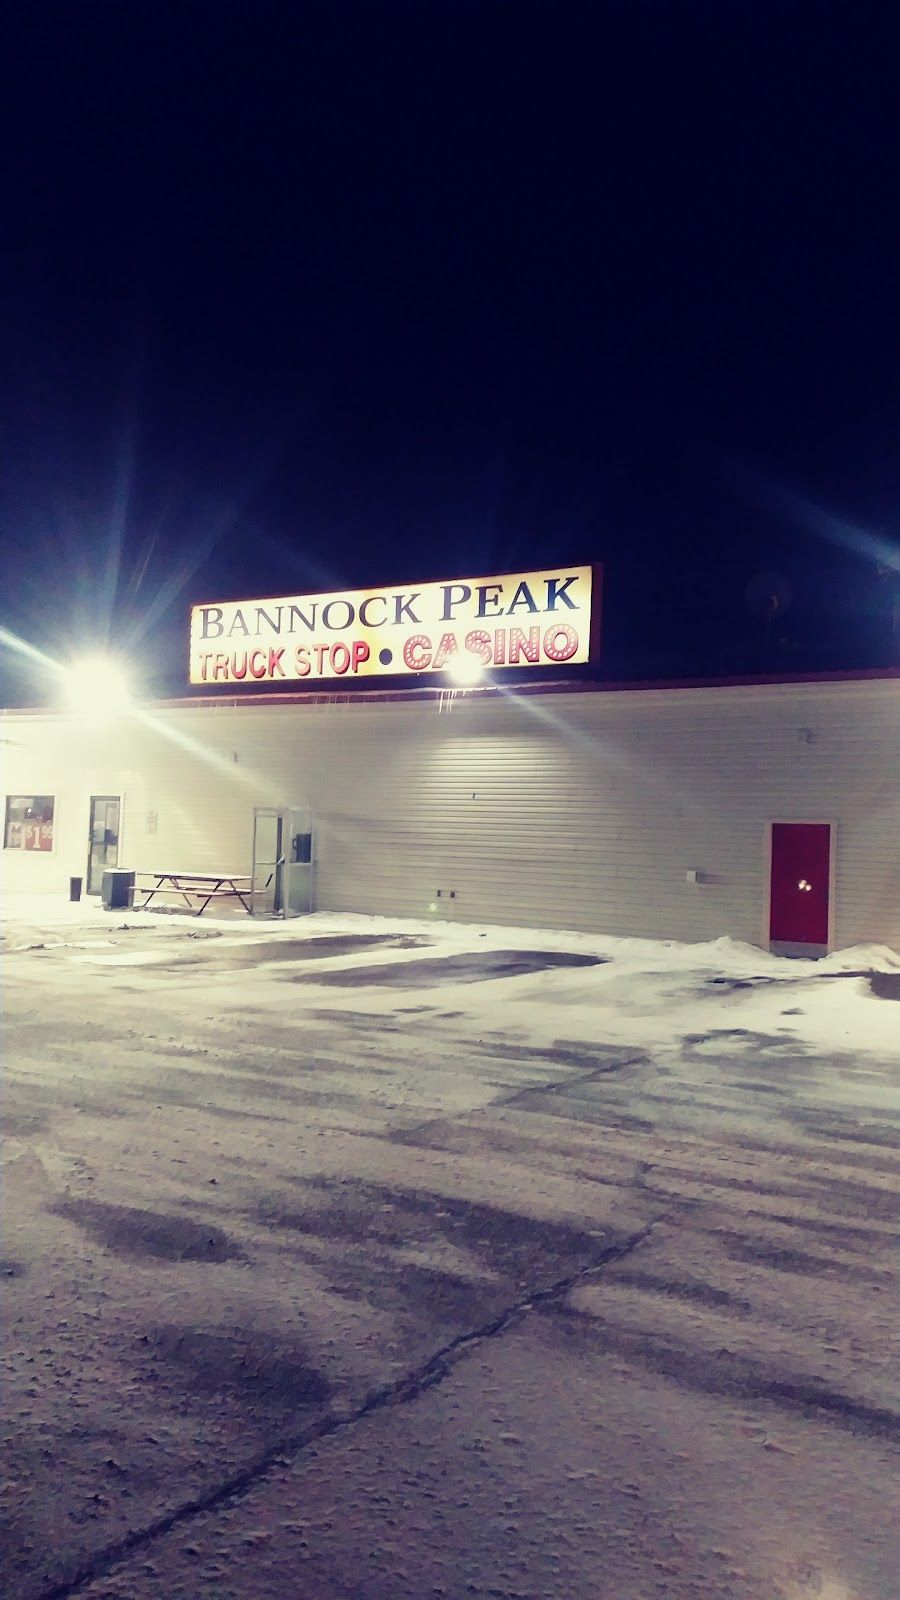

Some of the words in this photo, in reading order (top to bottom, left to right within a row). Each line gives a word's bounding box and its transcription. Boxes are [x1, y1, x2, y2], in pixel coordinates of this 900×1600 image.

[199, 593, 422, 640] BANNOCK
[438, 576, 580, 622] PEAK
[198, 646, 286, 681] TRUCK
[294, 640, 371, 675] STOP
[402, 623, 580, 671] CASINO
